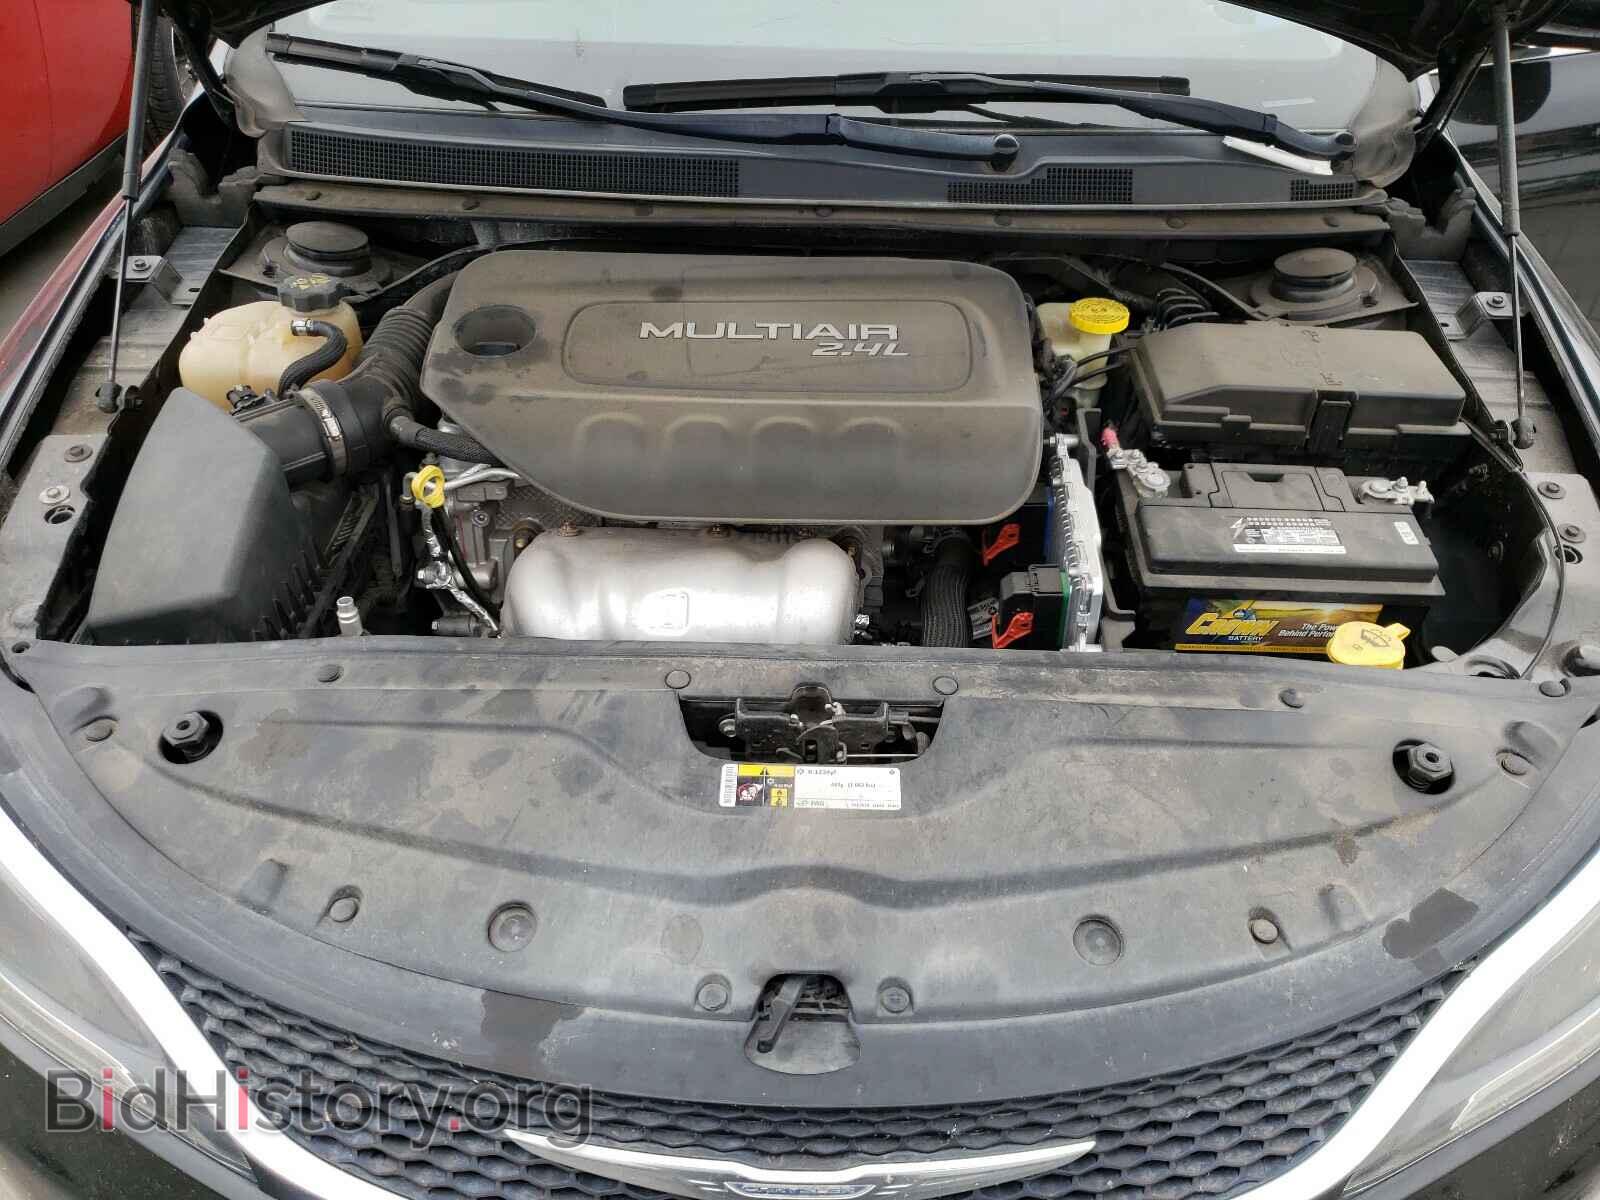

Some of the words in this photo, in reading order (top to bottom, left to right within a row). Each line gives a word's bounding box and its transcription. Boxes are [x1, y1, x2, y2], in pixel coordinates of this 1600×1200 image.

[639, 321, 899, 341] MULTIAIR
[811, 342, 909, 357] 2.4L
[1302, 623, 1317, 631] The
[1278, 629, 1308, 638] Behind
